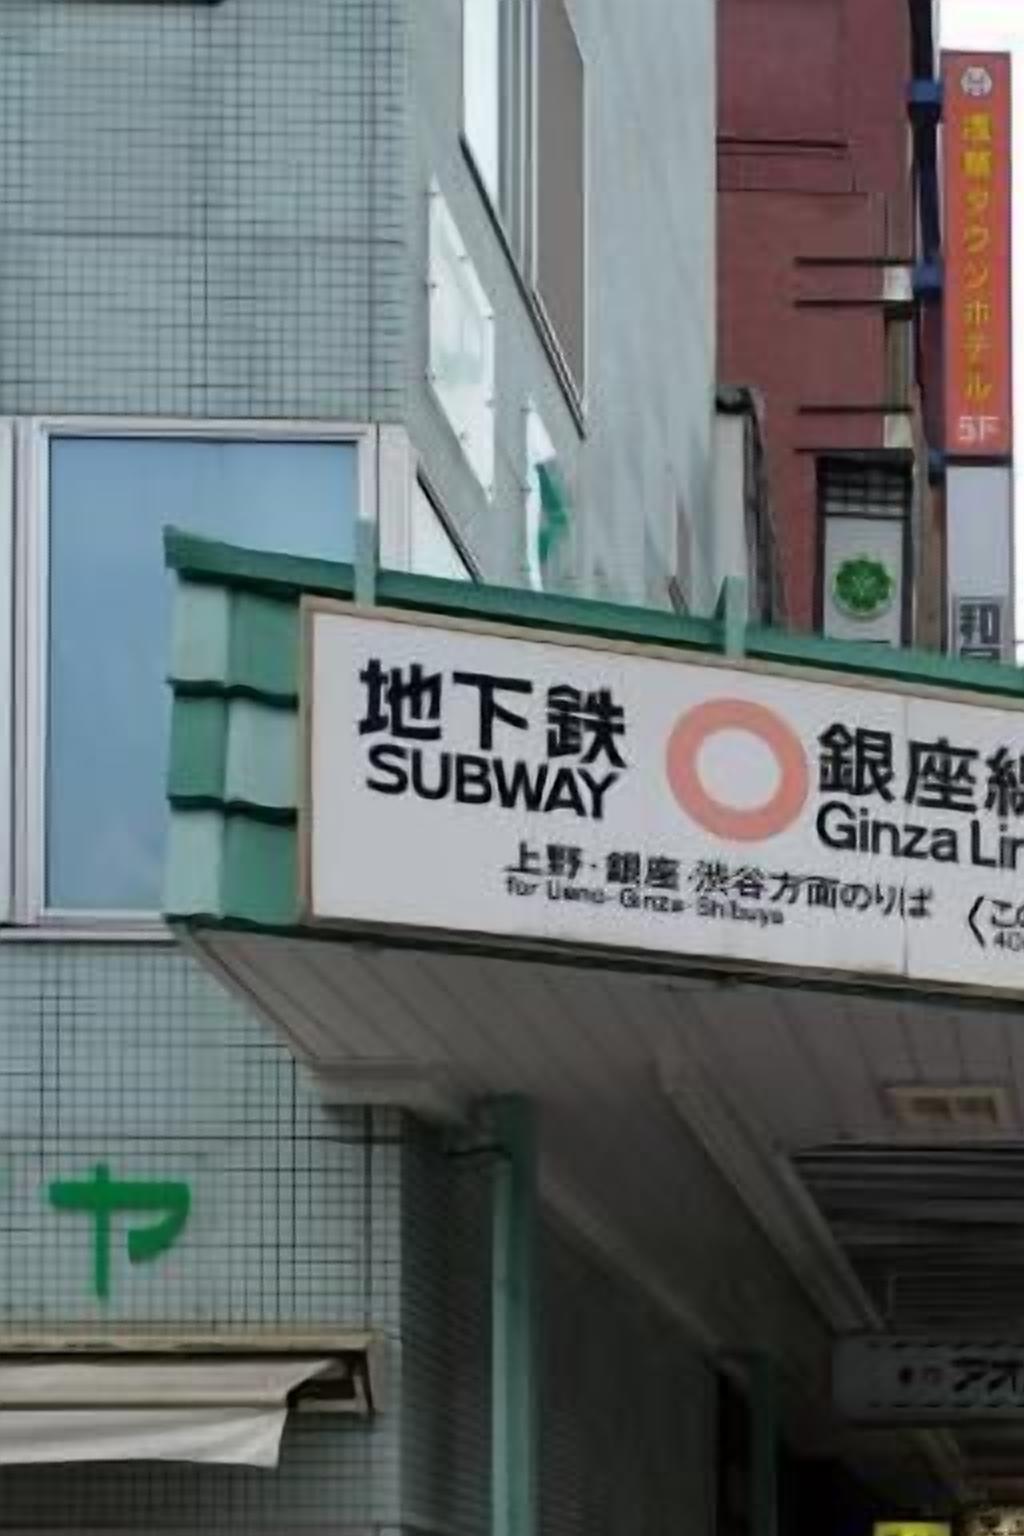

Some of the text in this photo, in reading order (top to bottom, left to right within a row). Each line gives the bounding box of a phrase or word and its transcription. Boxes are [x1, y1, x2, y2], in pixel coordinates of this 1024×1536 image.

[357, 657, 627, 769] 地下鉄
[366, 743, 618, 820] SUBWAY
[816, 800, 960, 864] Ginza
